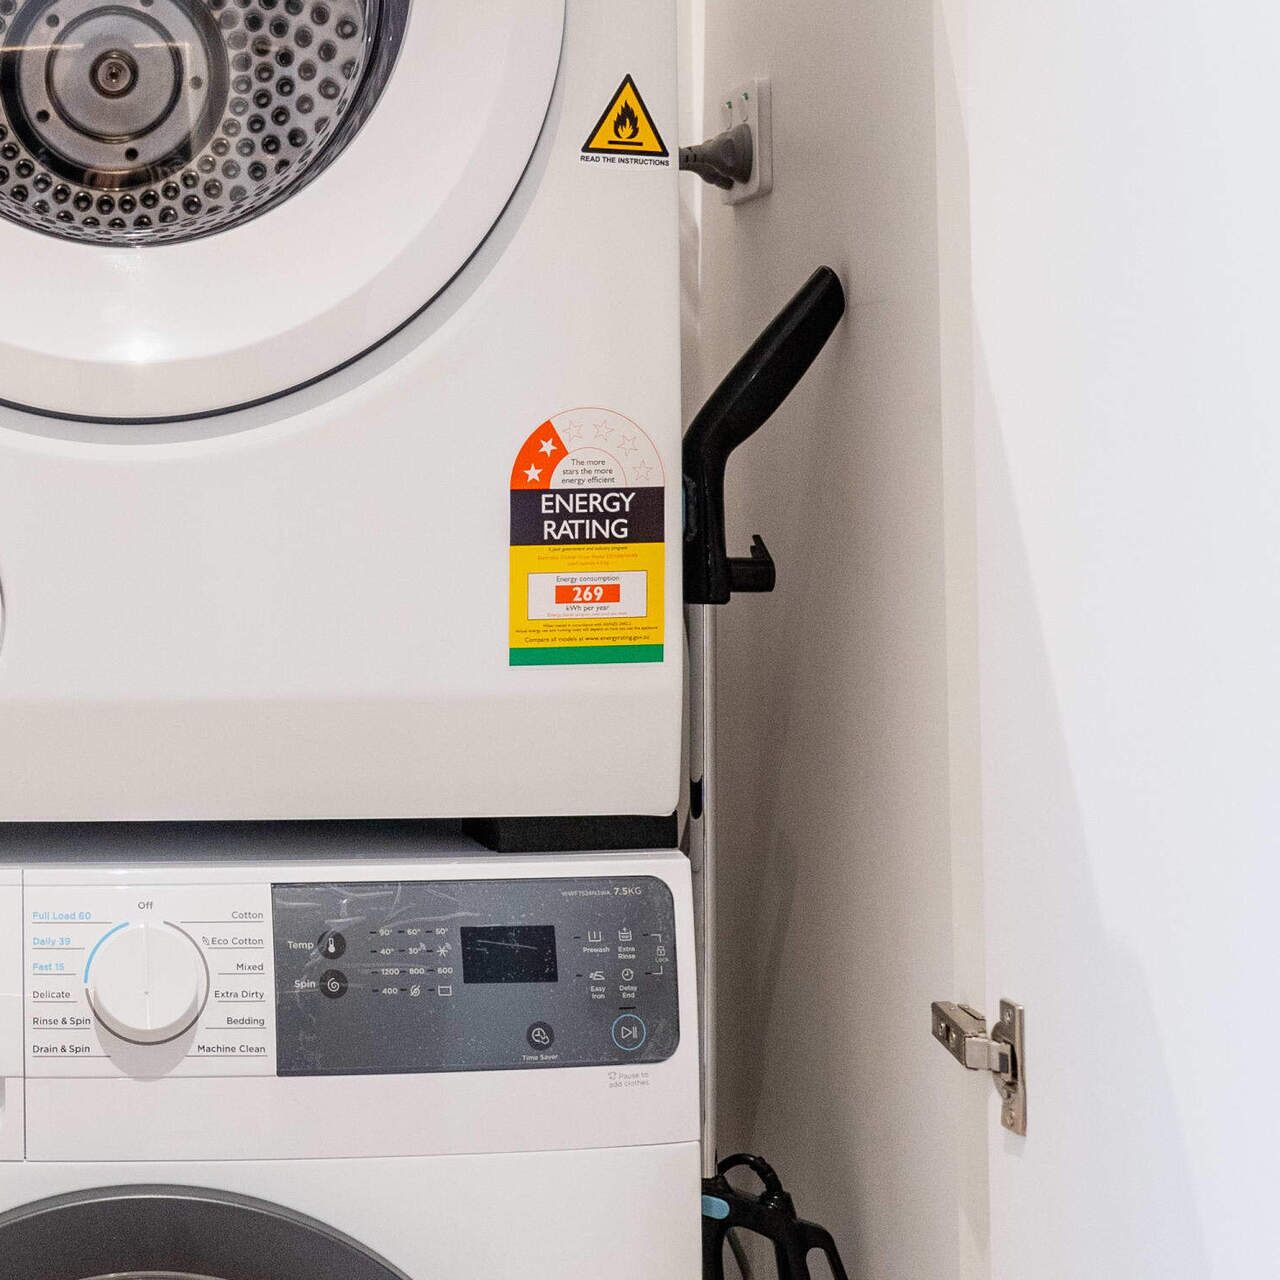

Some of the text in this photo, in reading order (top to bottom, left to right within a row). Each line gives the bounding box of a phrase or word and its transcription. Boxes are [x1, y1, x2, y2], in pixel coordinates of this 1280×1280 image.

[580, 155, 670, 167] READ THE INSTRUCTIONS
[571, 458, 585, 466] The
[562, 468, 580, 476] stars
[561, 476, 615, 485] energy efficient
[541, 492, 636, 514] ENERGY
[543, 518, 628, 540] RATING
[555, 575, 620, 584] Energy consumption
[572, 587, 604, 602] 269
[583, 605, 594, 613] per
[595, 605, 610, 613] year
[613, 887, 642, 896] 7.5KG
[138, 901, 153, 910] Off
[32, 911, 91, 920] Full Load 60
[231, 911, 264, 919] Cotton
[32, 937, 71, 947] Daily 39
[211, 937, 264, 945] Eco Cotton
[288, 941, 314, 950] Temp
[32, 962, 65, 971] Fast 15
[236, 963, 264, 971] Mixed
[294, 979, 316, 989] Spin
[32, 990, 71, 999] Delicate
[214, 990, 264, 1000] Extra Dirty
[381, 987, 398, 995] 400
[32, 1017, 91, 1026] Rinse & Spin
[226, 1017, 265, 1026] Bedding
[32, 1045, 91, 1055] Drain & Spin
[197, 1045, 266, 1053] Machine Clean
